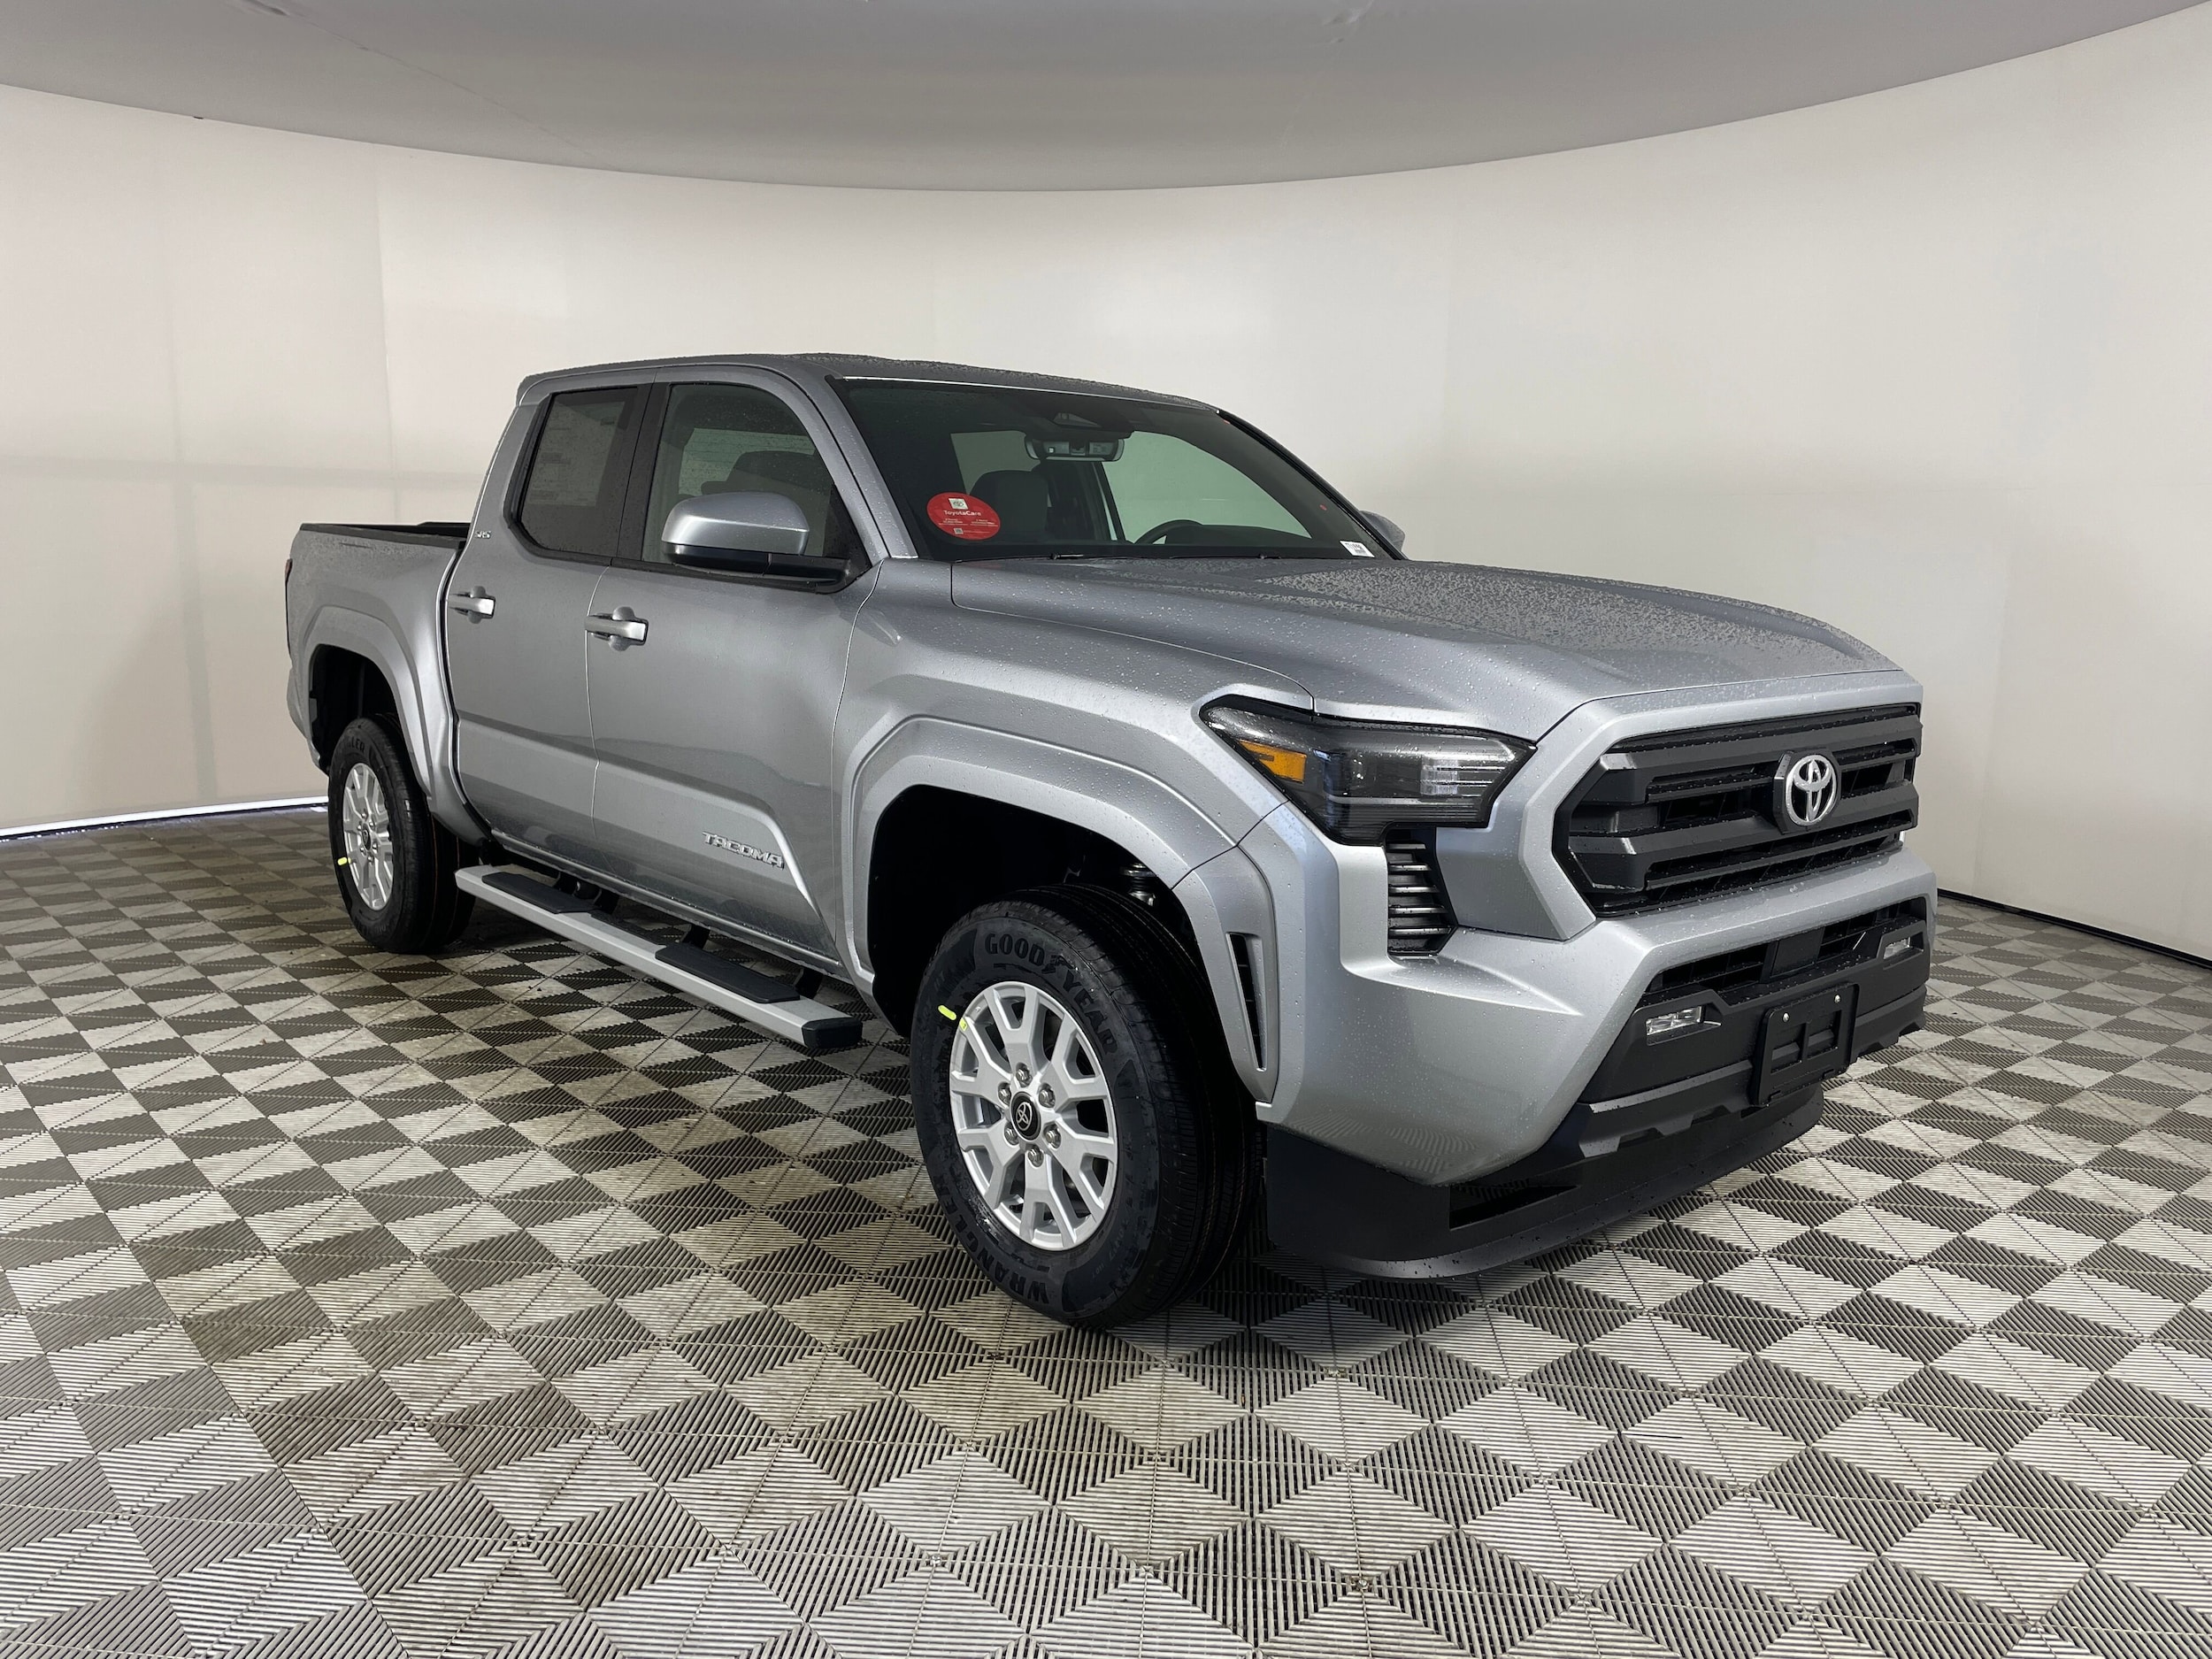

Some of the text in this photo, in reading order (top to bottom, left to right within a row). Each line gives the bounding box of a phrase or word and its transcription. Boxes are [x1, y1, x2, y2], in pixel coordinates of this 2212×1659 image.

[702, 831, 785, 870] TACOMA
[984, 933, 1118, 1056] GOODYEAR
[934, 1172, 1050, 1305] WRANGLER
